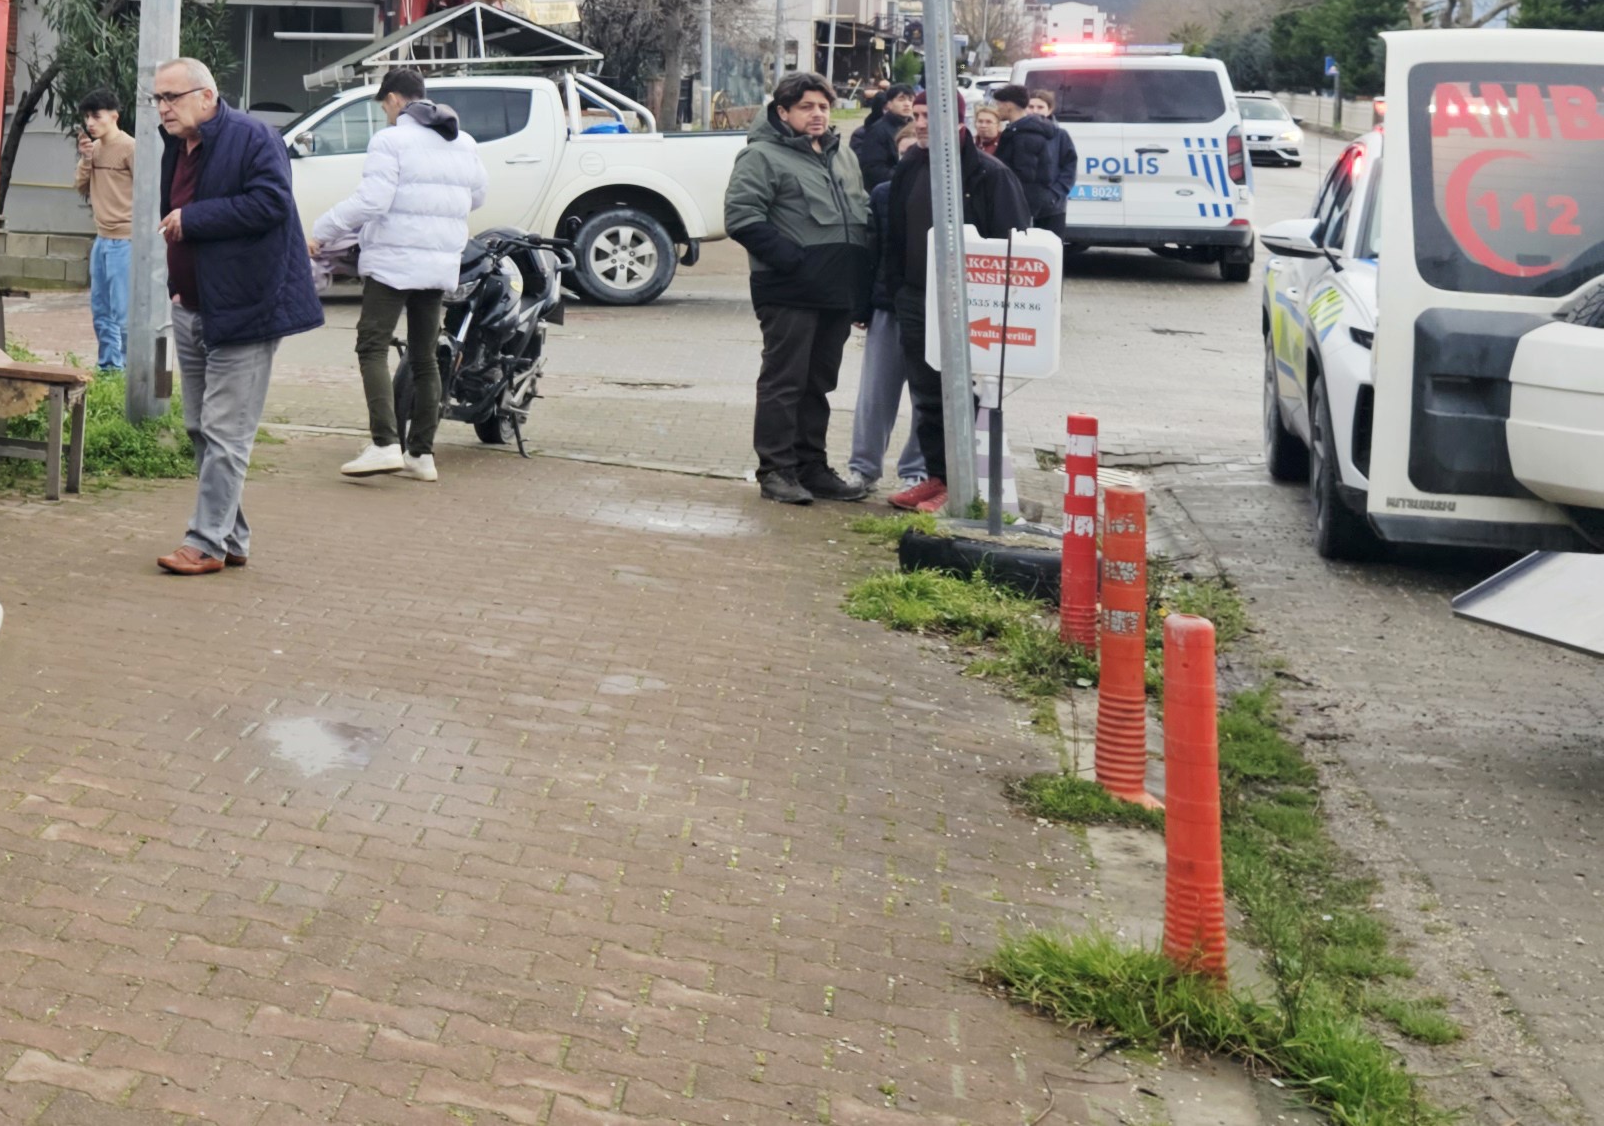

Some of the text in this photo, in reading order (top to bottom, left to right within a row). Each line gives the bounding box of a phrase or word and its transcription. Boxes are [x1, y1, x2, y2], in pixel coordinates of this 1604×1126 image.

[1431, 83, 1604, 140] AMB
[1086, 152, 1159, 175] POLİS
[1078, 187, 1119, 197] A 8024
[1013, 302, 1026, 310] 88
[1028, 303, 1041, 311] 86
[1006, 332, 1033, 341] erilir
